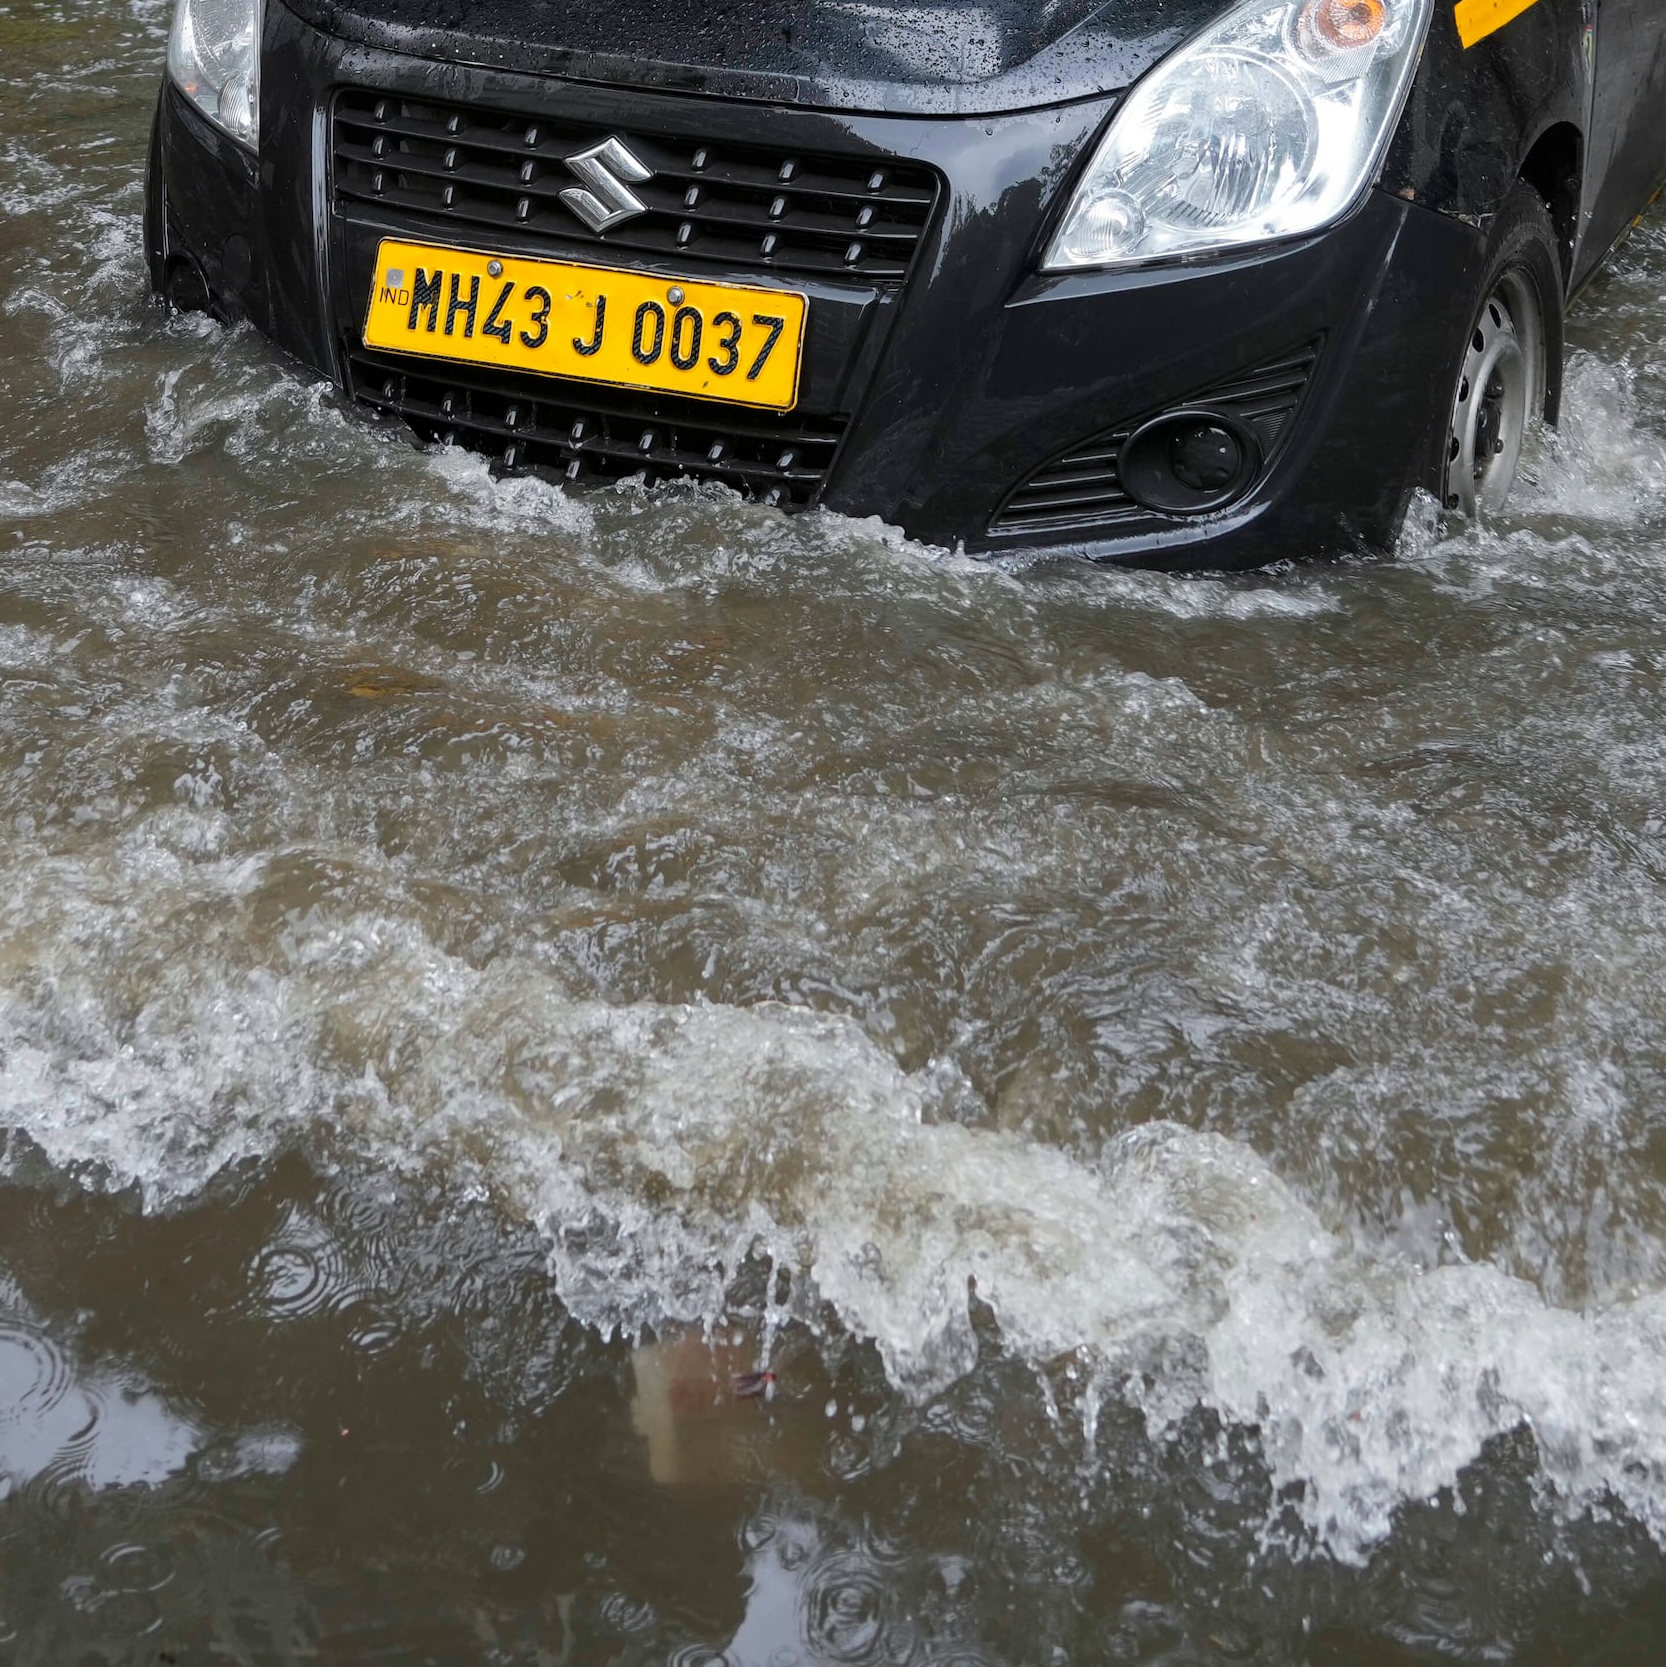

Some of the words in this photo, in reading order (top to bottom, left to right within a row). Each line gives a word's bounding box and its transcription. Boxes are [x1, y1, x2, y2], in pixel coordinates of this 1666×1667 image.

[379, 287, 409, 306] IND
[407, 267, 552, 349] MH43
[571, 294, 607, 357] J
[631, 300, 784, 380] 0037
